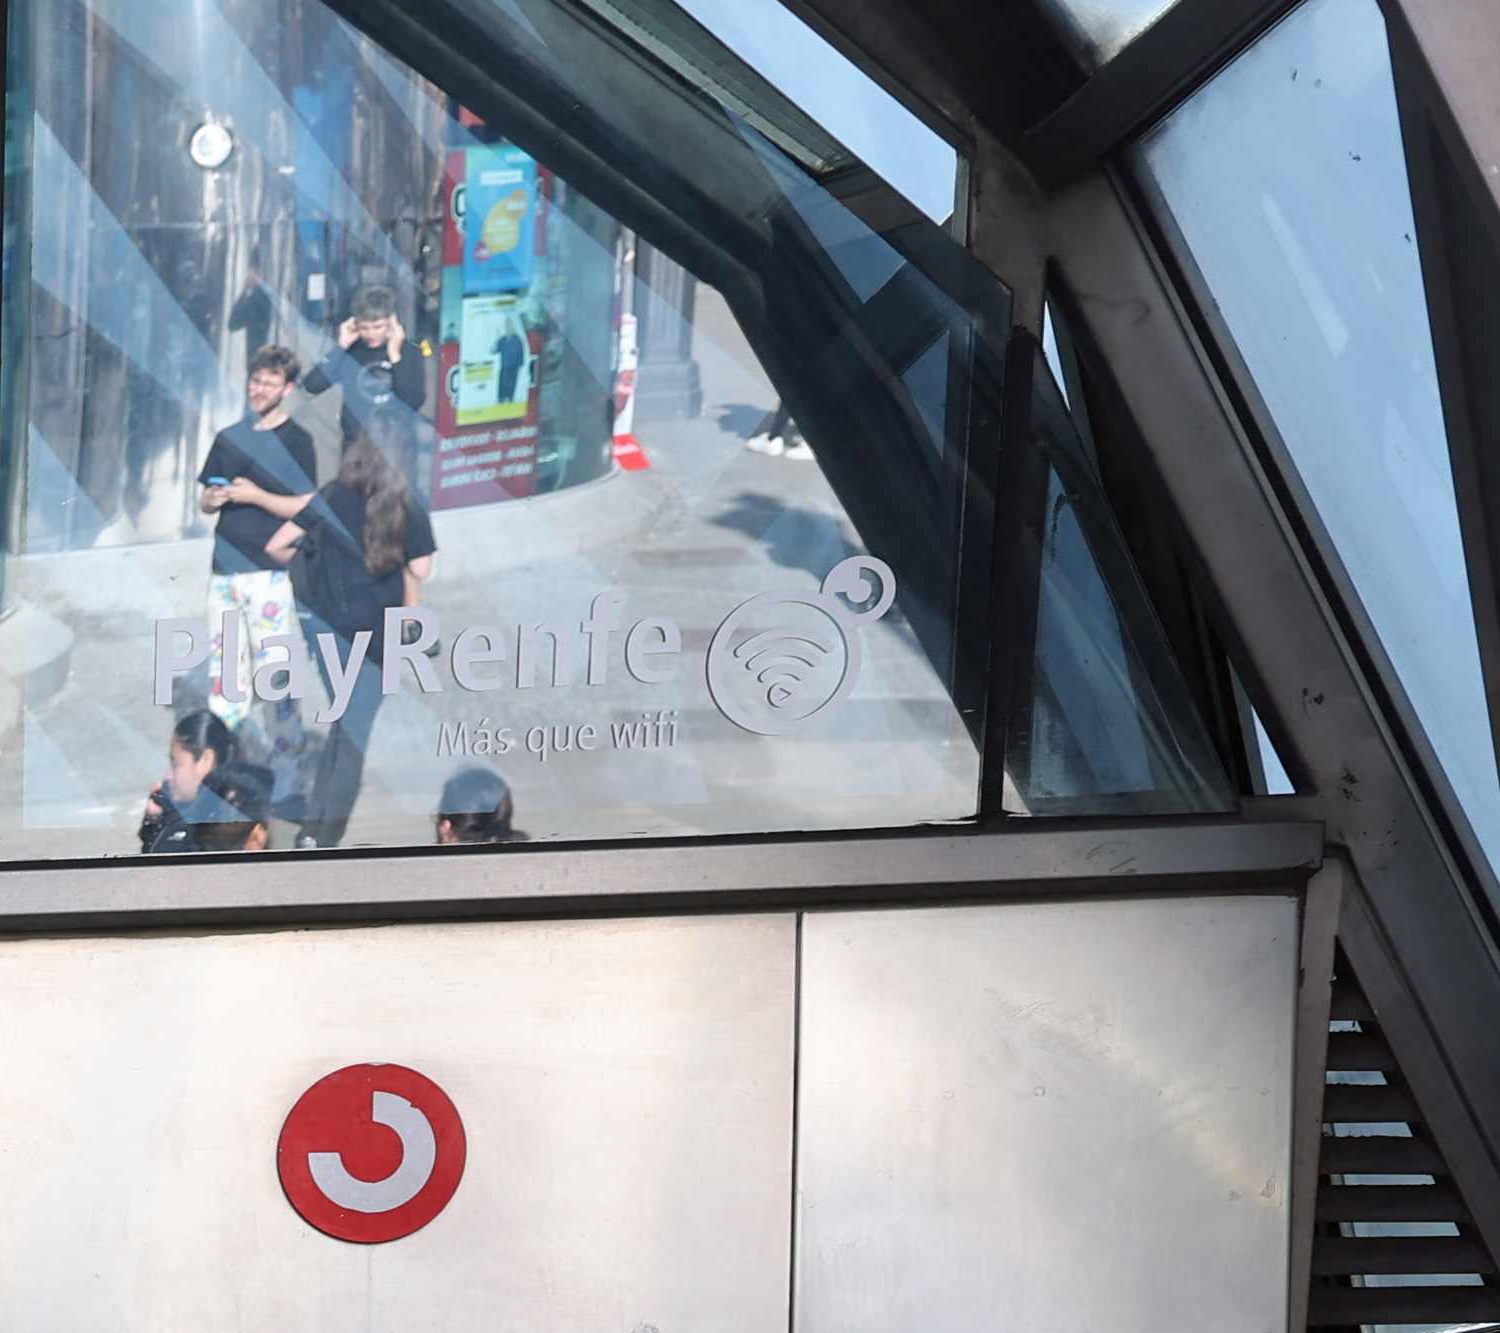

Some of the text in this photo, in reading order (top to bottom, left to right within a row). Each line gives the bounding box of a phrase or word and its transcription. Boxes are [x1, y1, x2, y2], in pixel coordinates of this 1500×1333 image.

[153, 590, 683, 724] PlayRenfe
[437, 710, 680, 762] Más que wifi
